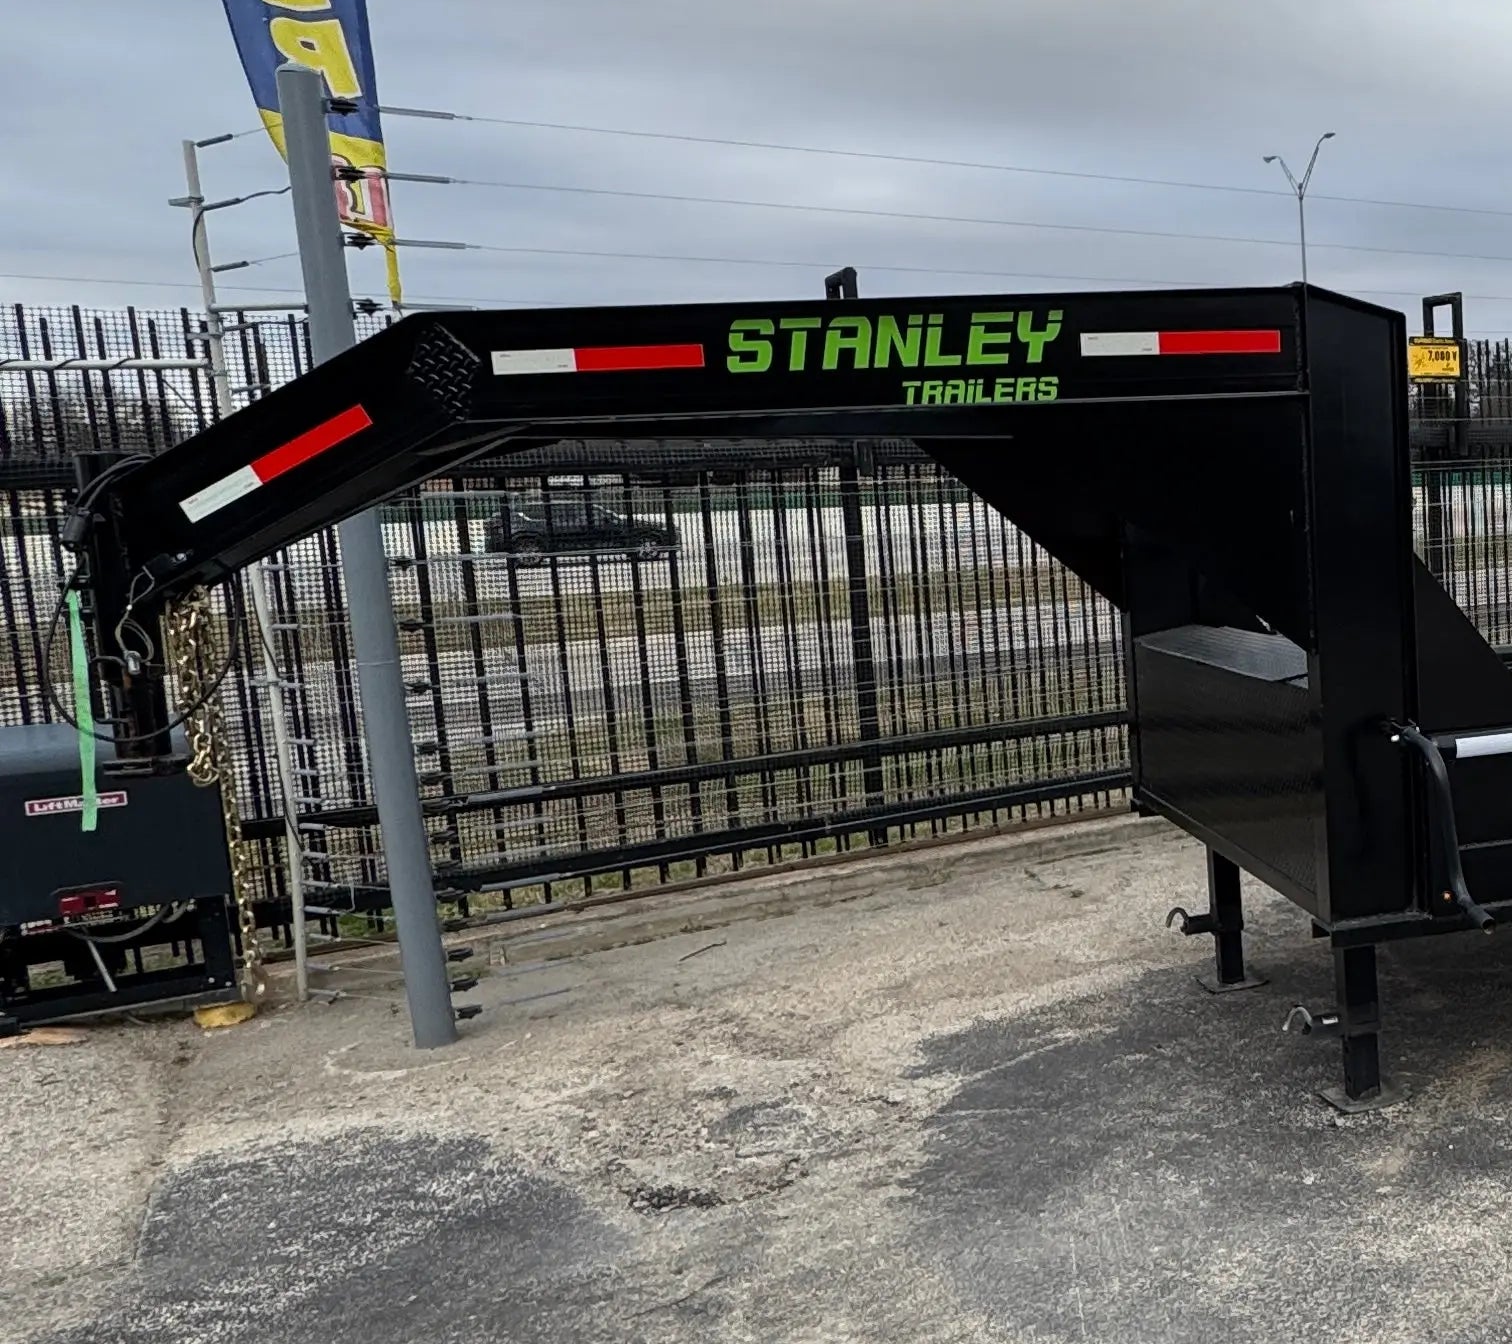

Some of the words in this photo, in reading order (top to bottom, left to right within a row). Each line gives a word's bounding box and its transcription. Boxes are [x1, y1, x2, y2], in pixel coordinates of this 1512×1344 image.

[727, 310, 1063, 373] STANLEY
[1428, 350, 1450, 362] 7,000
[902, 376, 1059, 405] TRAILERS
